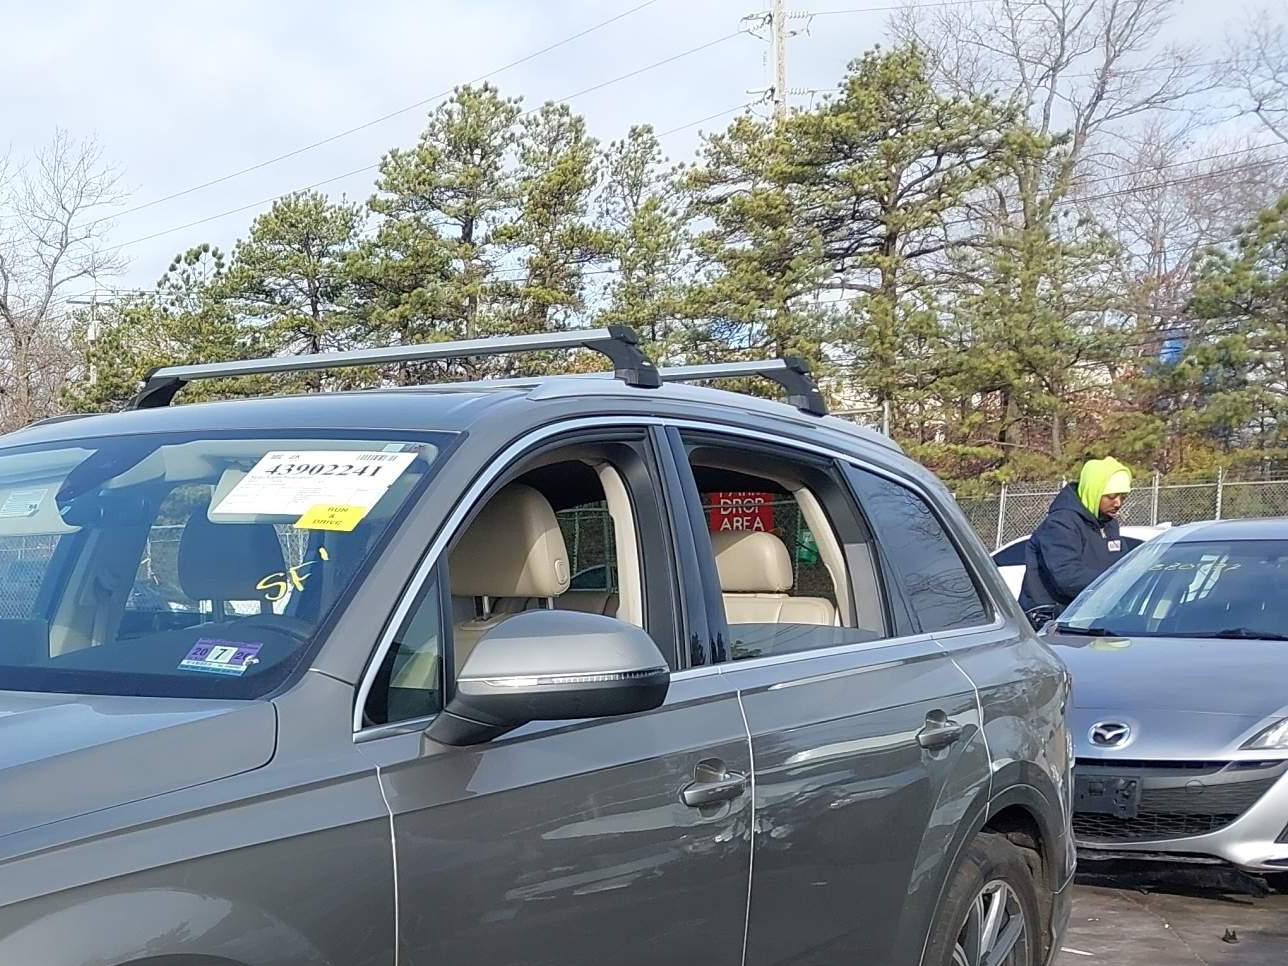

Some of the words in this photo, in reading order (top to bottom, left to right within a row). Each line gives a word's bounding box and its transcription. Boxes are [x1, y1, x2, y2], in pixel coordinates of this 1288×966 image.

[266, 464, 382, 476] 43902241
[720, 498, 764, 514] DROP
[719, 516, 765, 532] AREA
[192, 647, 208, 655] 20
[214, 648, 227, 660] 7
